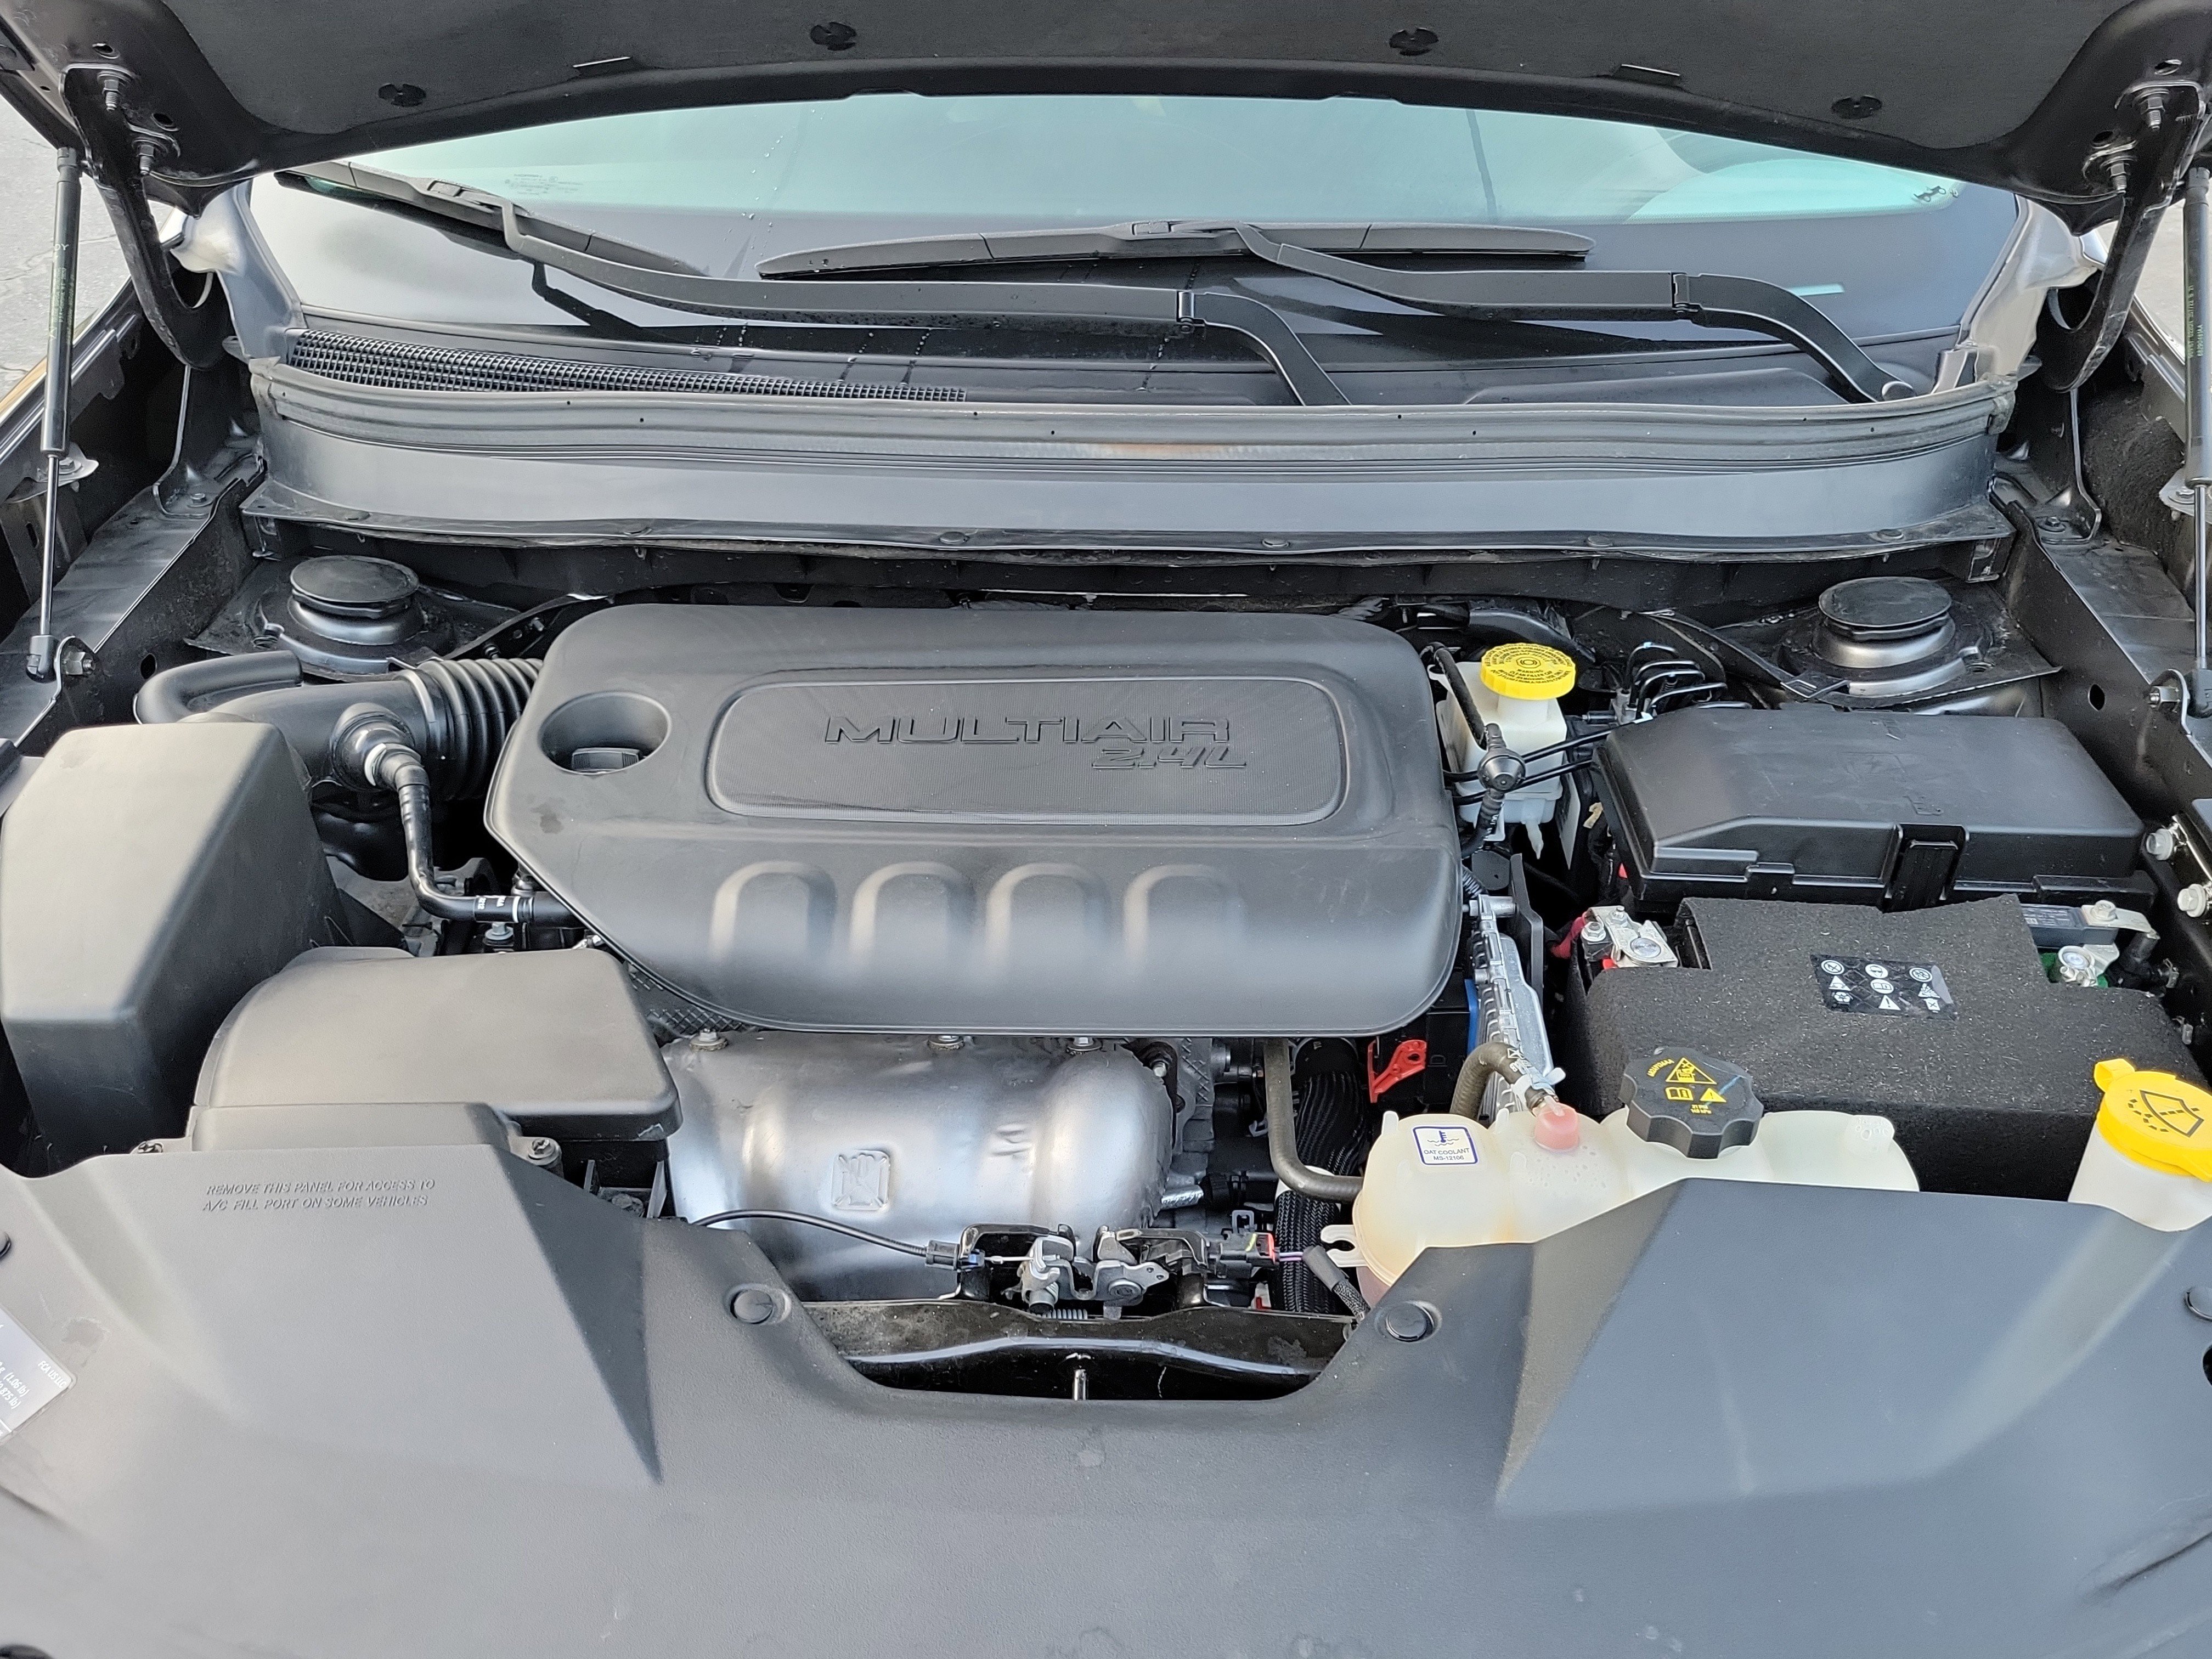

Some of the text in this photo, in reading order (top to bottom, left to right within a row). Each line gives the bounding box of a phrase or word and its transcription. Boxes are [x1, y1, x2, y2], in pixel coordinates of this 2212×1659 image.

[824, 715, 1231, 745] MULTIAIR
[1091, 746, 1248, 770] 2.4L
[206, 1178, 436, 1195] REMOVE THIS PANEL FOR ACCESS TO
[202, 1194, 428, 1212] A/C FILL PORT ON SOME VEHICLES
[38, 1361, 52, 1374] FCA
[48, 1370, 59, 1380] US
[3, 1372, 22, 1390] (1.06
